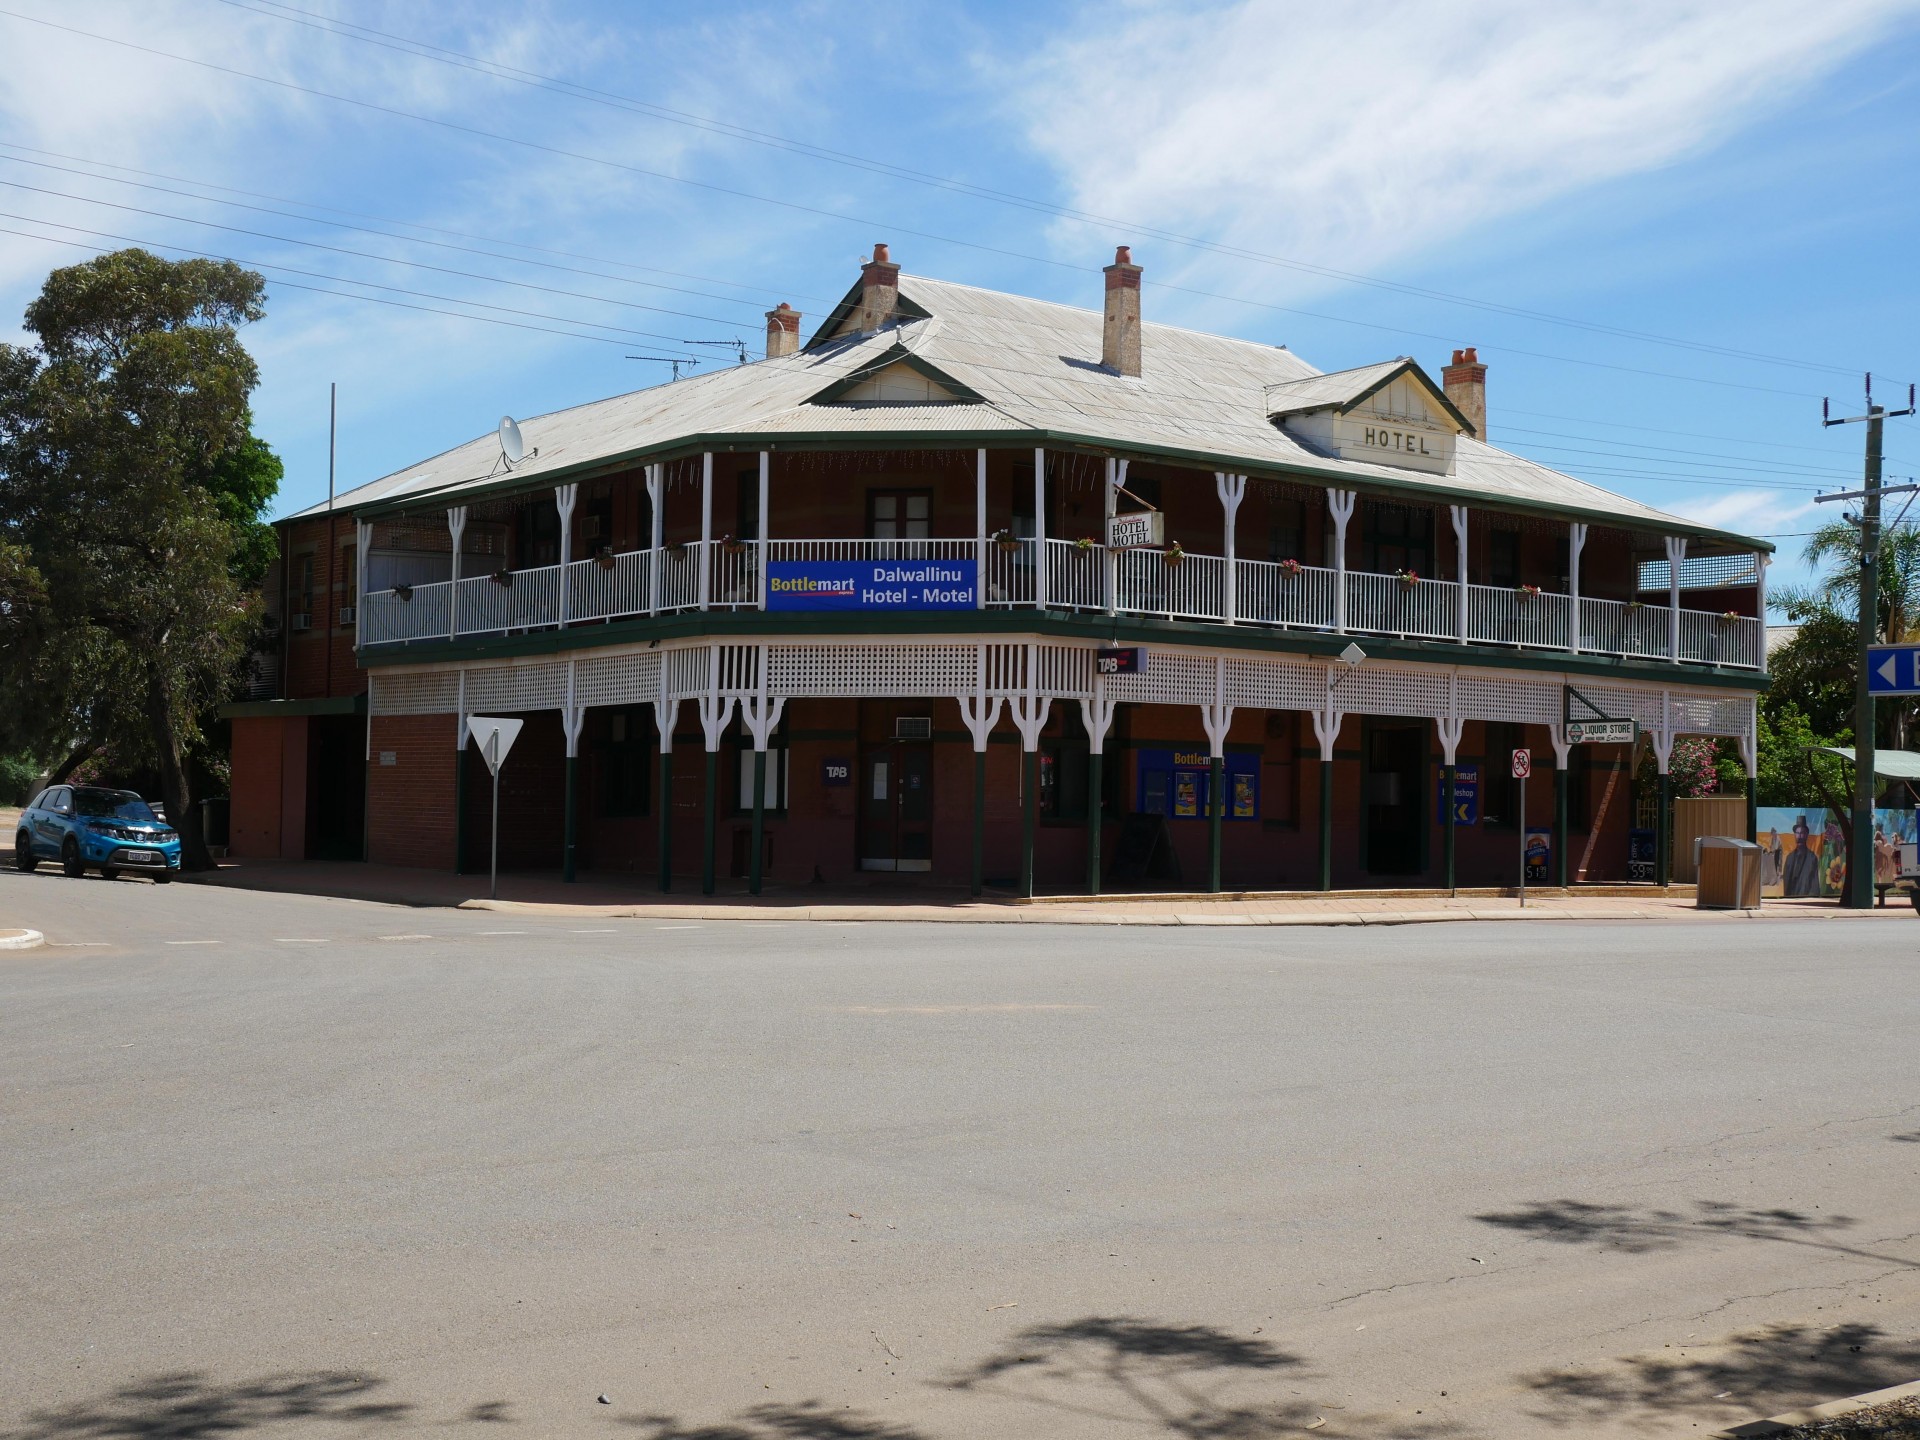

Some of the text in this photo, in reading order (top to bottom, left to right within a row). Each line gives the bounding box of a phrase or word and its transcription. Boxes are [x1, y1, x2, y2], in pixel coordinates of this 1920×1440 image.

[1365, 427, 1430, 455] HOTEL
[1112, 521, 1149, 536] HOTEL
[1112, 532, 1150, 547] MOTEL
[873, 566, 962, 582] Dalwallinu
[771, 577, 855, 592] Bottlemart
[862, 588, 907, 603] Hotel
[923, 588, 973, 603] Motel
[1098, 657, 1118, 673] TAB
[1584, 724, 1607, 735] LIQUOR
[1609, 724, 1631, 734] STORE
[1174, 752, 1225, 765] Bottlemt
[825, 766, 848, 778] TAB
[1439, 769, 1478, 781] Blemart
